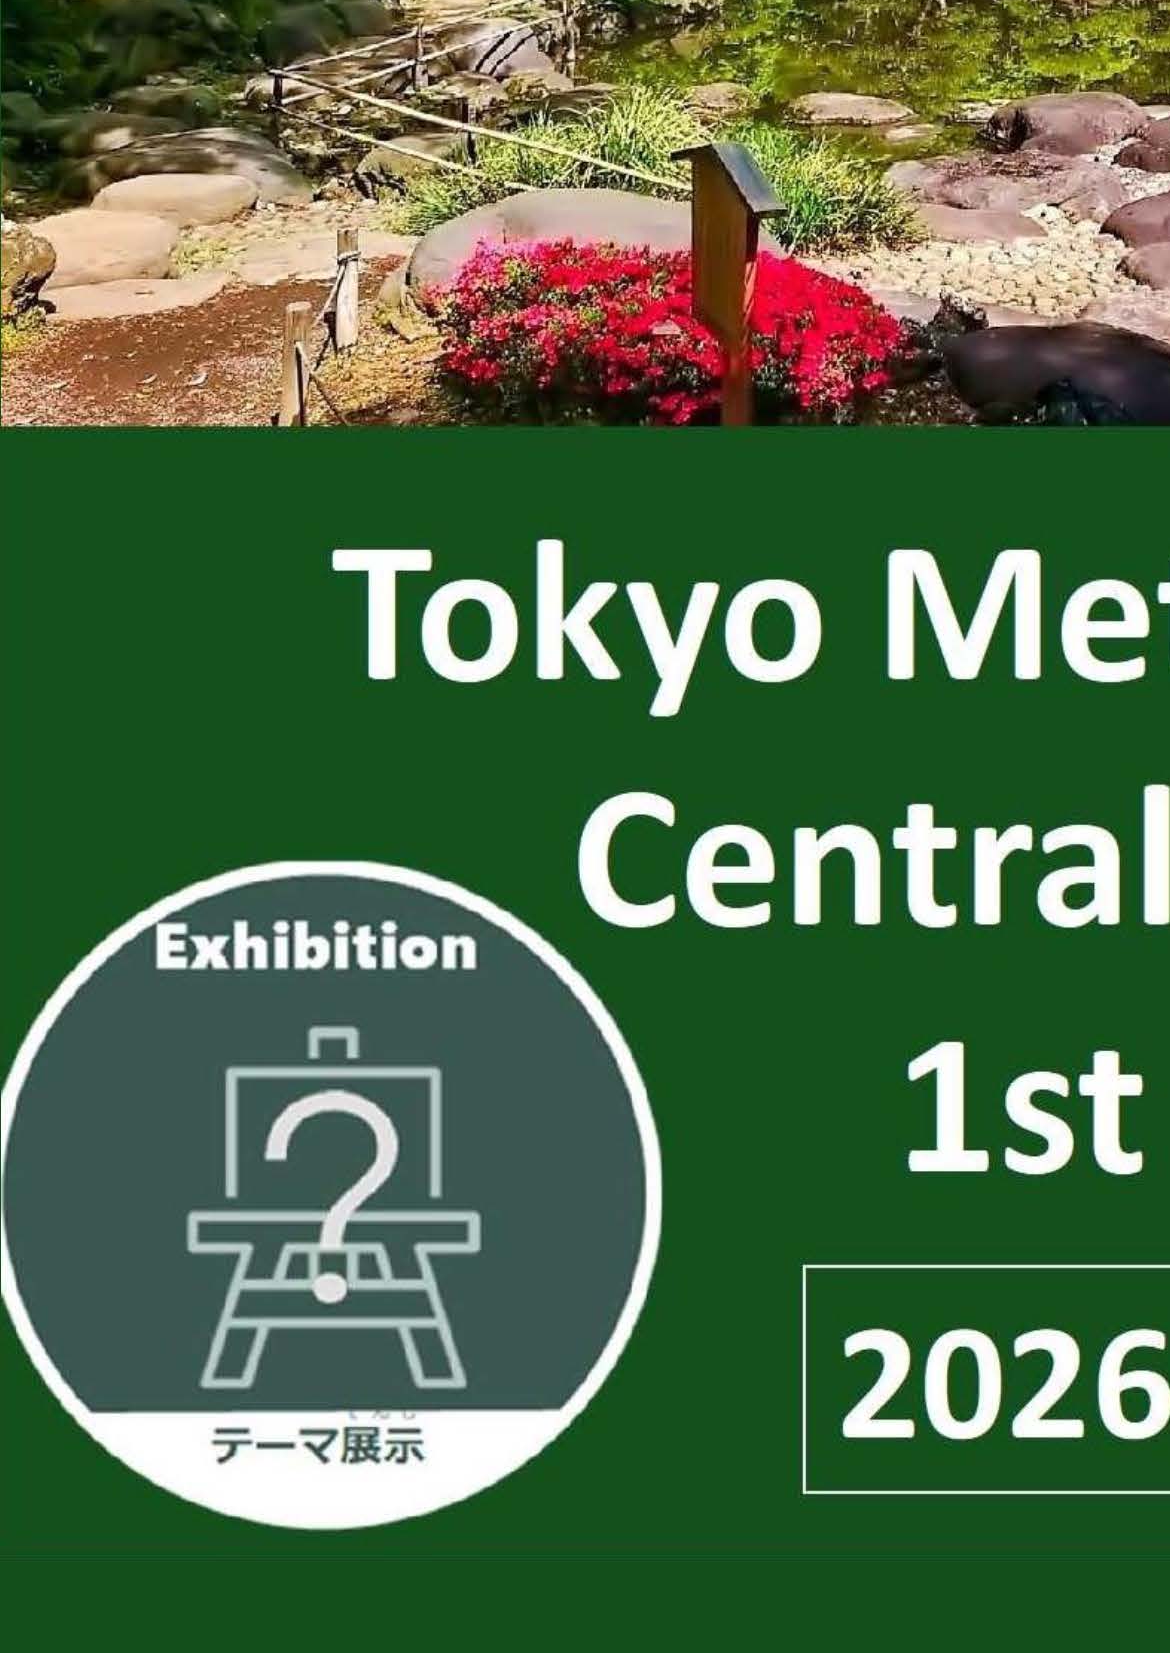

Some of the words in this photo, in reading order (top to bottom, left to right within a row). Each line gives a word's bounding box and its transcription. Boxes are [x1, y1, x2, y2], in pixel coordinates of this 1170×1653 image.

[331, 538, 824, 718] Tokyo
[154, 919, 478, 971] Exhibition
[906, 1040, 1146, 1177] 1st
[211, 1426, 425, 1465] テーマ展示
